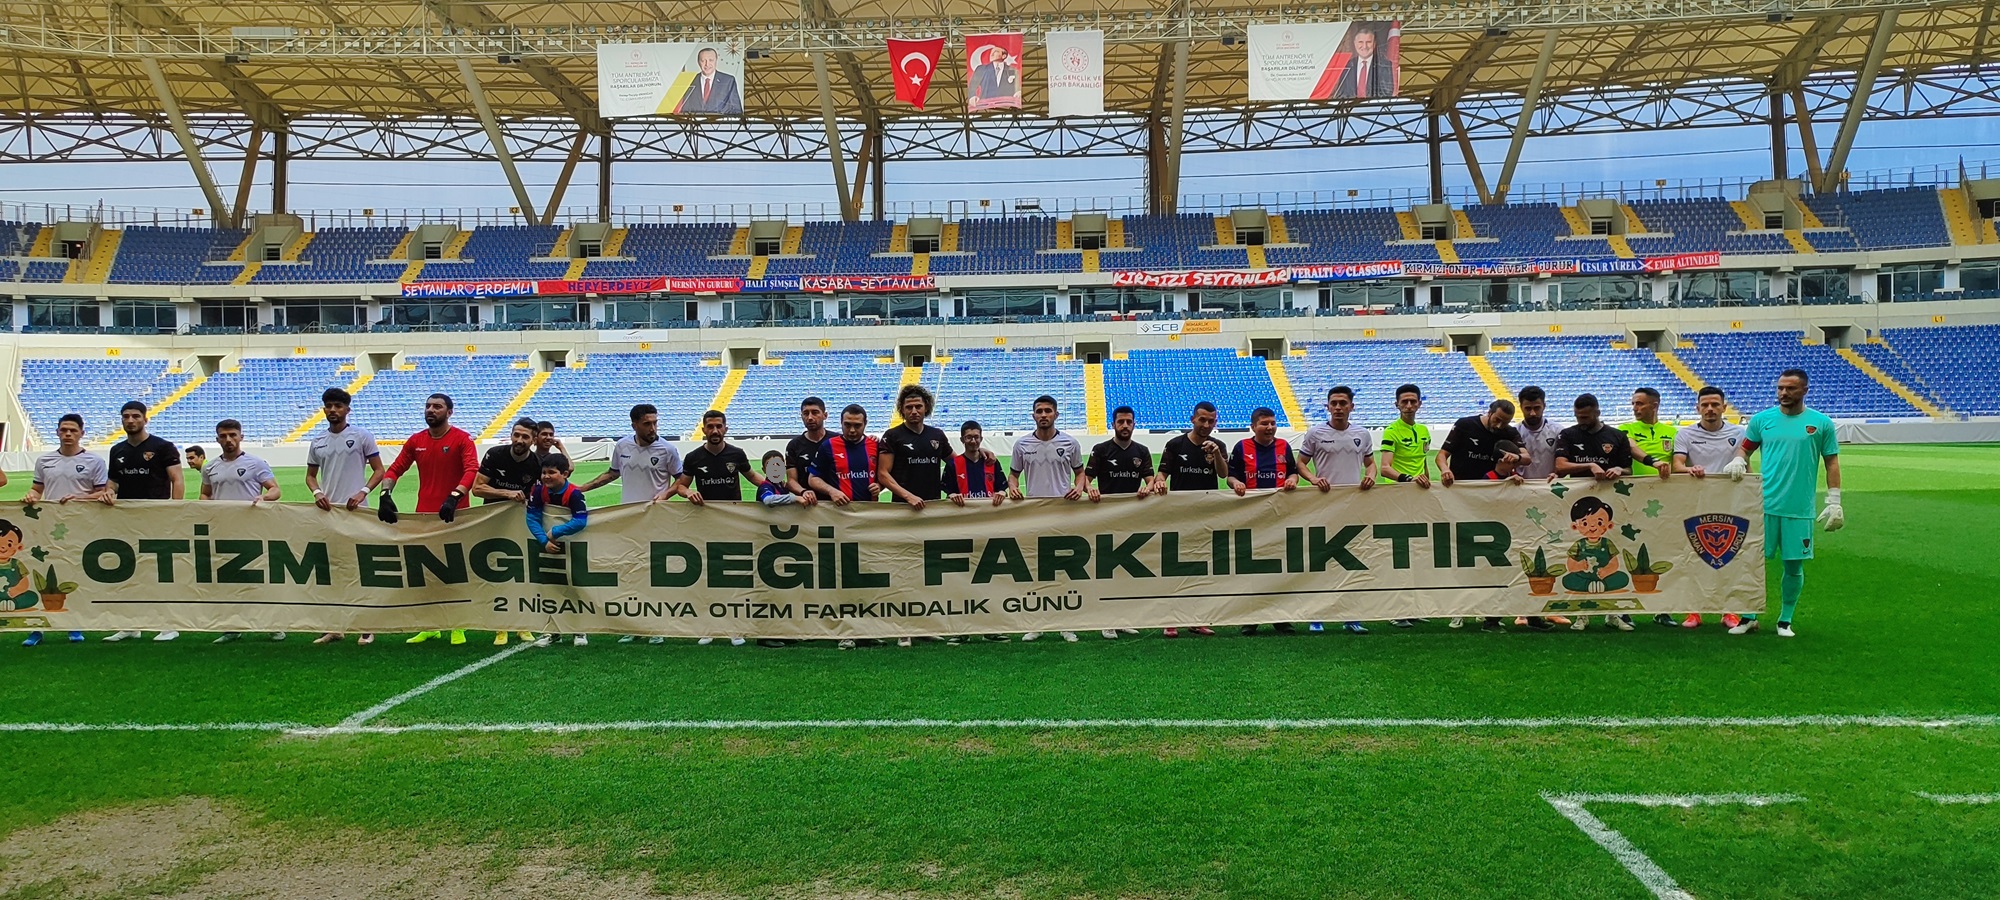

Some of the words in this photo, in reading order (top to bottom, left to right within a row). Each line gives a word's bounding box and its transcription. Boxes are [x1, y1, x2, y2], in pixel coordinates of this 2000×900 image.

[1292, 267, 1334, 279] YERALTI
[1346, 263, 1401, 278] CLASSICAL
[1404, 263, 1447, 275] KIRMIZI
[1538, 261, 1573, 271] GURUR
[1581, 261, 1608, 273] CESUR
[706, 280, 734, 289] GURURU
[804, 278, 853, 290] KASABA
[1113, 272, 1188, 286] KIRMIZI
[1153, 324, 1179, 332] SCB
[82, 524, 332, 586] OTİZM
[356, 538, 619, 589] ENGEL
[650, 525, 891, 590] DEĞİL
[923, 521, 1513, 587] FARKLILIKTIR
[493, 597, 508, 612] 2
[519, 593, 596, 615] NİSAN
[605, 597, 698, 618] DÜNYA
[709, 599, 793, 619] OTİZM
[804, 598, 990, 619] FARKINDALIK
[1002, 590, 1083, 613] GÜNÜ
